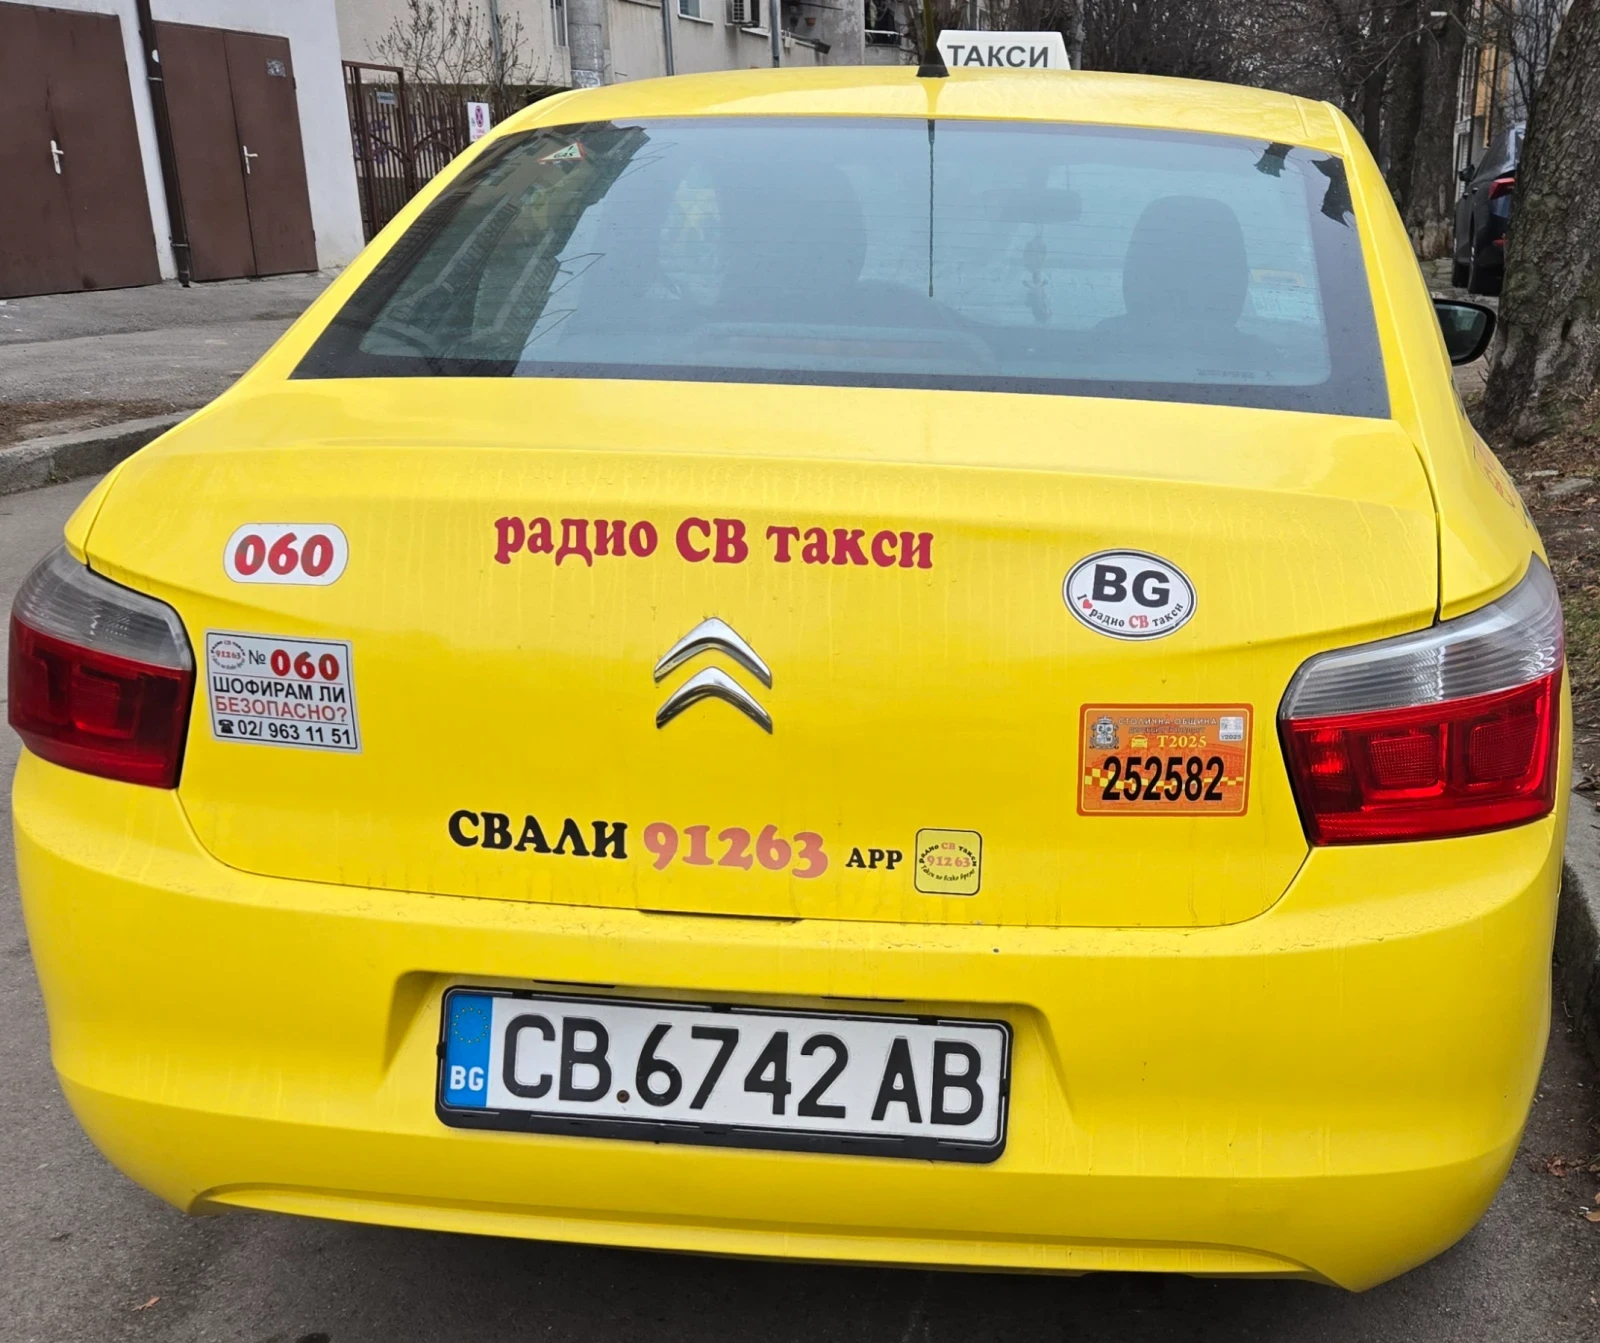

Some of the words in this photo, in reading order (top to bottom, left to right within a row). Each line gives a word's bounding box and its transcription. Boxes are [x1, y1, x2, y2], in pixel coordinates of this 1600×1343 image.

[946, 44, 1049, 68] ТАКСИ
[234, 532, 334, 577] 060
[494, 516, 658, 568] радио
[675, 516, 749, 564] СВ
[766, 525, 934, 569] такси
[1091, 563, 1171, 609] BG
[1128, 615, 1149, 629] СВ
[270, 649, 340, 682] 060
[213, 676, 313, 701] ШОФИРАМ
[319, 686, 346, 704] ЛИ
[215, 695, 347, 723] БЕЗОПАСНО?
[1118, 717, 1171, 725] СТОЛИЧНА
[1174, 717, 1217, 726] ОБЩИНА
[237, 719, 263, 737] 02/
[268, 722, 300, 741] 963
[305, 726, 324, 743] 11
[331, 728, 351, 745] 51
[1157, 735, 1207, 748] T2025
[1101, 755, 1224, 801] 252582
[448, 810, 628, 859] СВАЛИ
[643, 823, 828, 879] 91263
[845, 847, 902, 870] APP
[449, 1066, 485, 1091] BG
[502, 1014, 612, 1101] CB
[635, 1023, 849, 1118] 6742
[871, 1037, 983, 1125] AB
